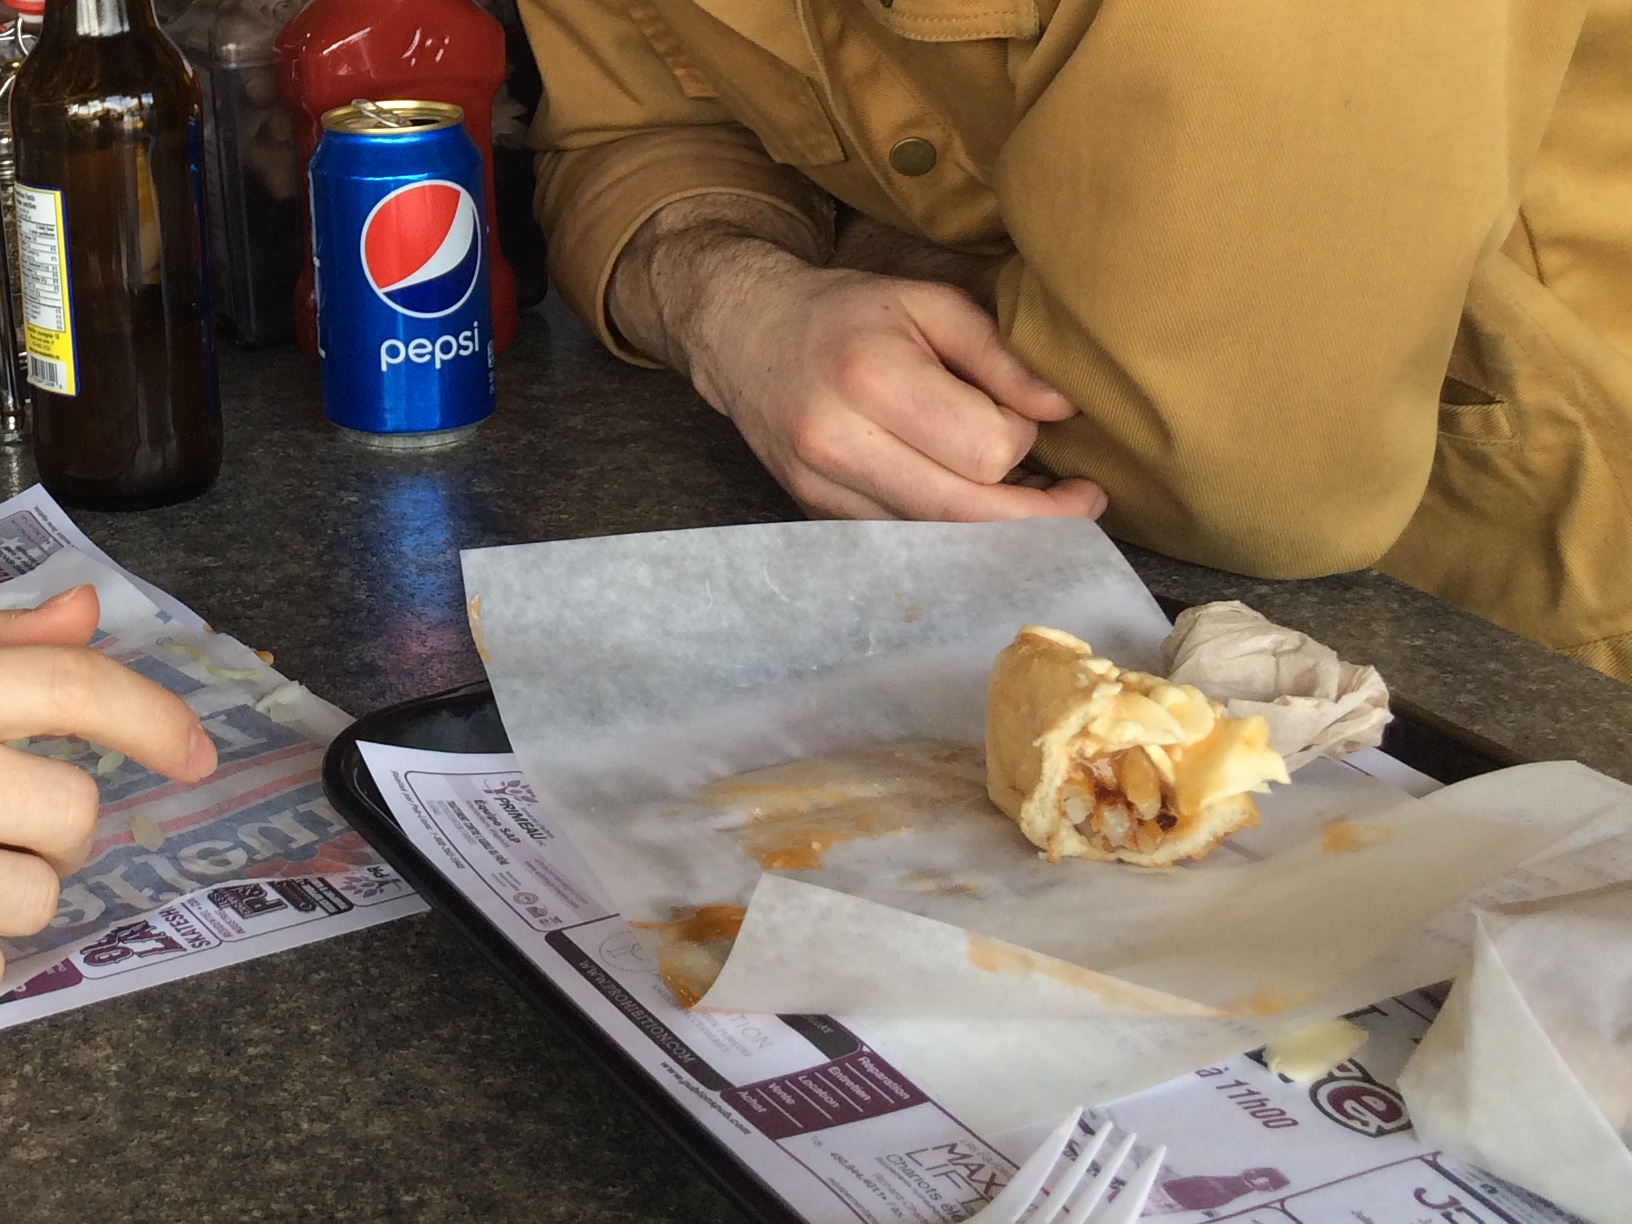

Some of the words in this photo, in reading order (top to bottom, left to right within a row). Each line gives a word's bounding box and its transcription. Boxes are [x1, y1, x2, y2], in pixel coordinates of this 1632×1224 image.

[379, 321, 479, 372] pepsi
[494, 797, 549, 842] PRIMEAU
[158, 906, 211, 949] SKATESH
[579, 959, 696, 1064] WWW.PROHIBITION.COM
[768, 1081, 797, 1106] Vente
[797, 1075, 841, 1109] Location
[827, 1065, 872, 1102] Entretien
[858, 1055, 911, 1101] Réparation
[737, 1089, 768, 1114] Achat
[1215, 1078, 1300, 1129] 11h00
[885, 1153, 944, 1203] Chariots
